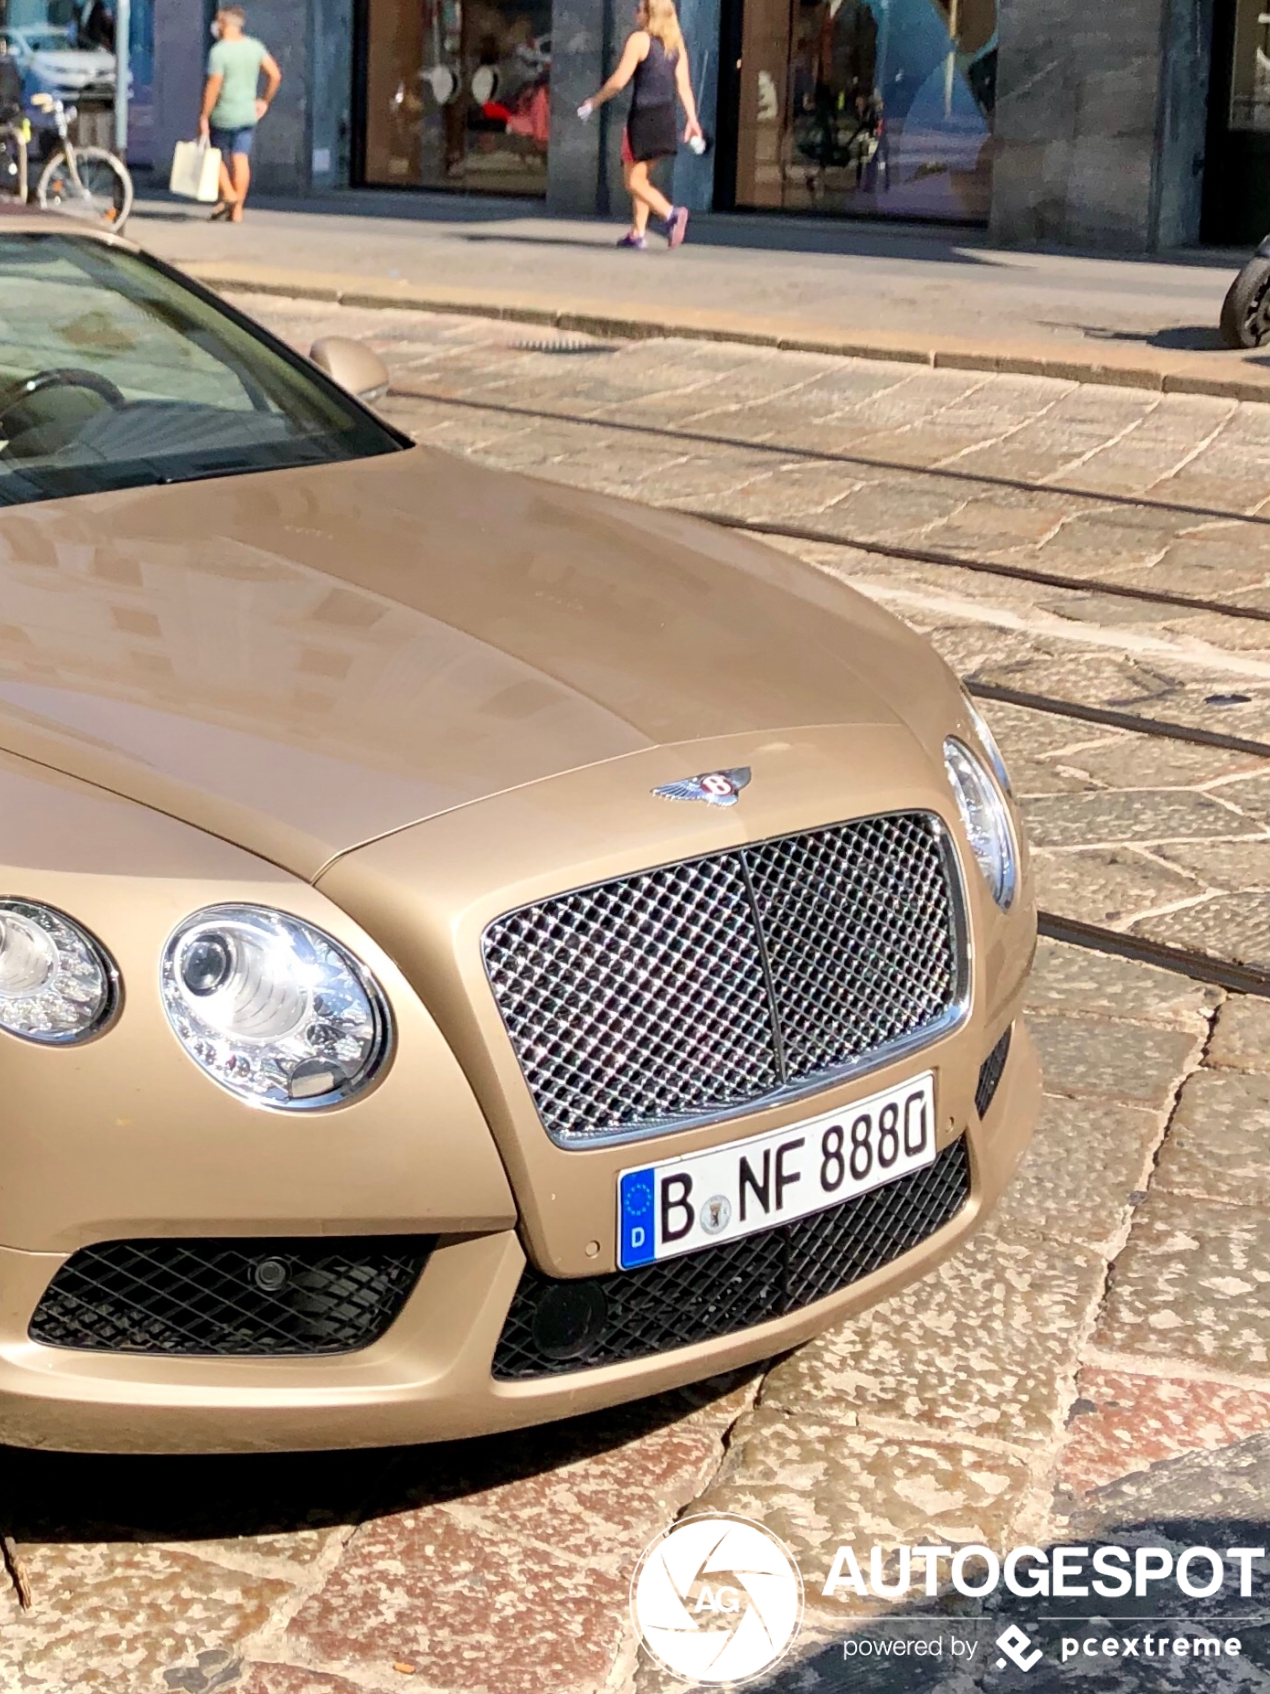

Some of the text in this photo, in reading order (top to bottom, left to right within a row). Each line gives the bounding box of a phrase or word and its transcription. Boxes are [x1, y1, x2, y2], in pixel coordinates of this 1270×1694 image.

[660, 1090, 928, 1245] B NF 8880
[631, 1227, 645, 1248] D
